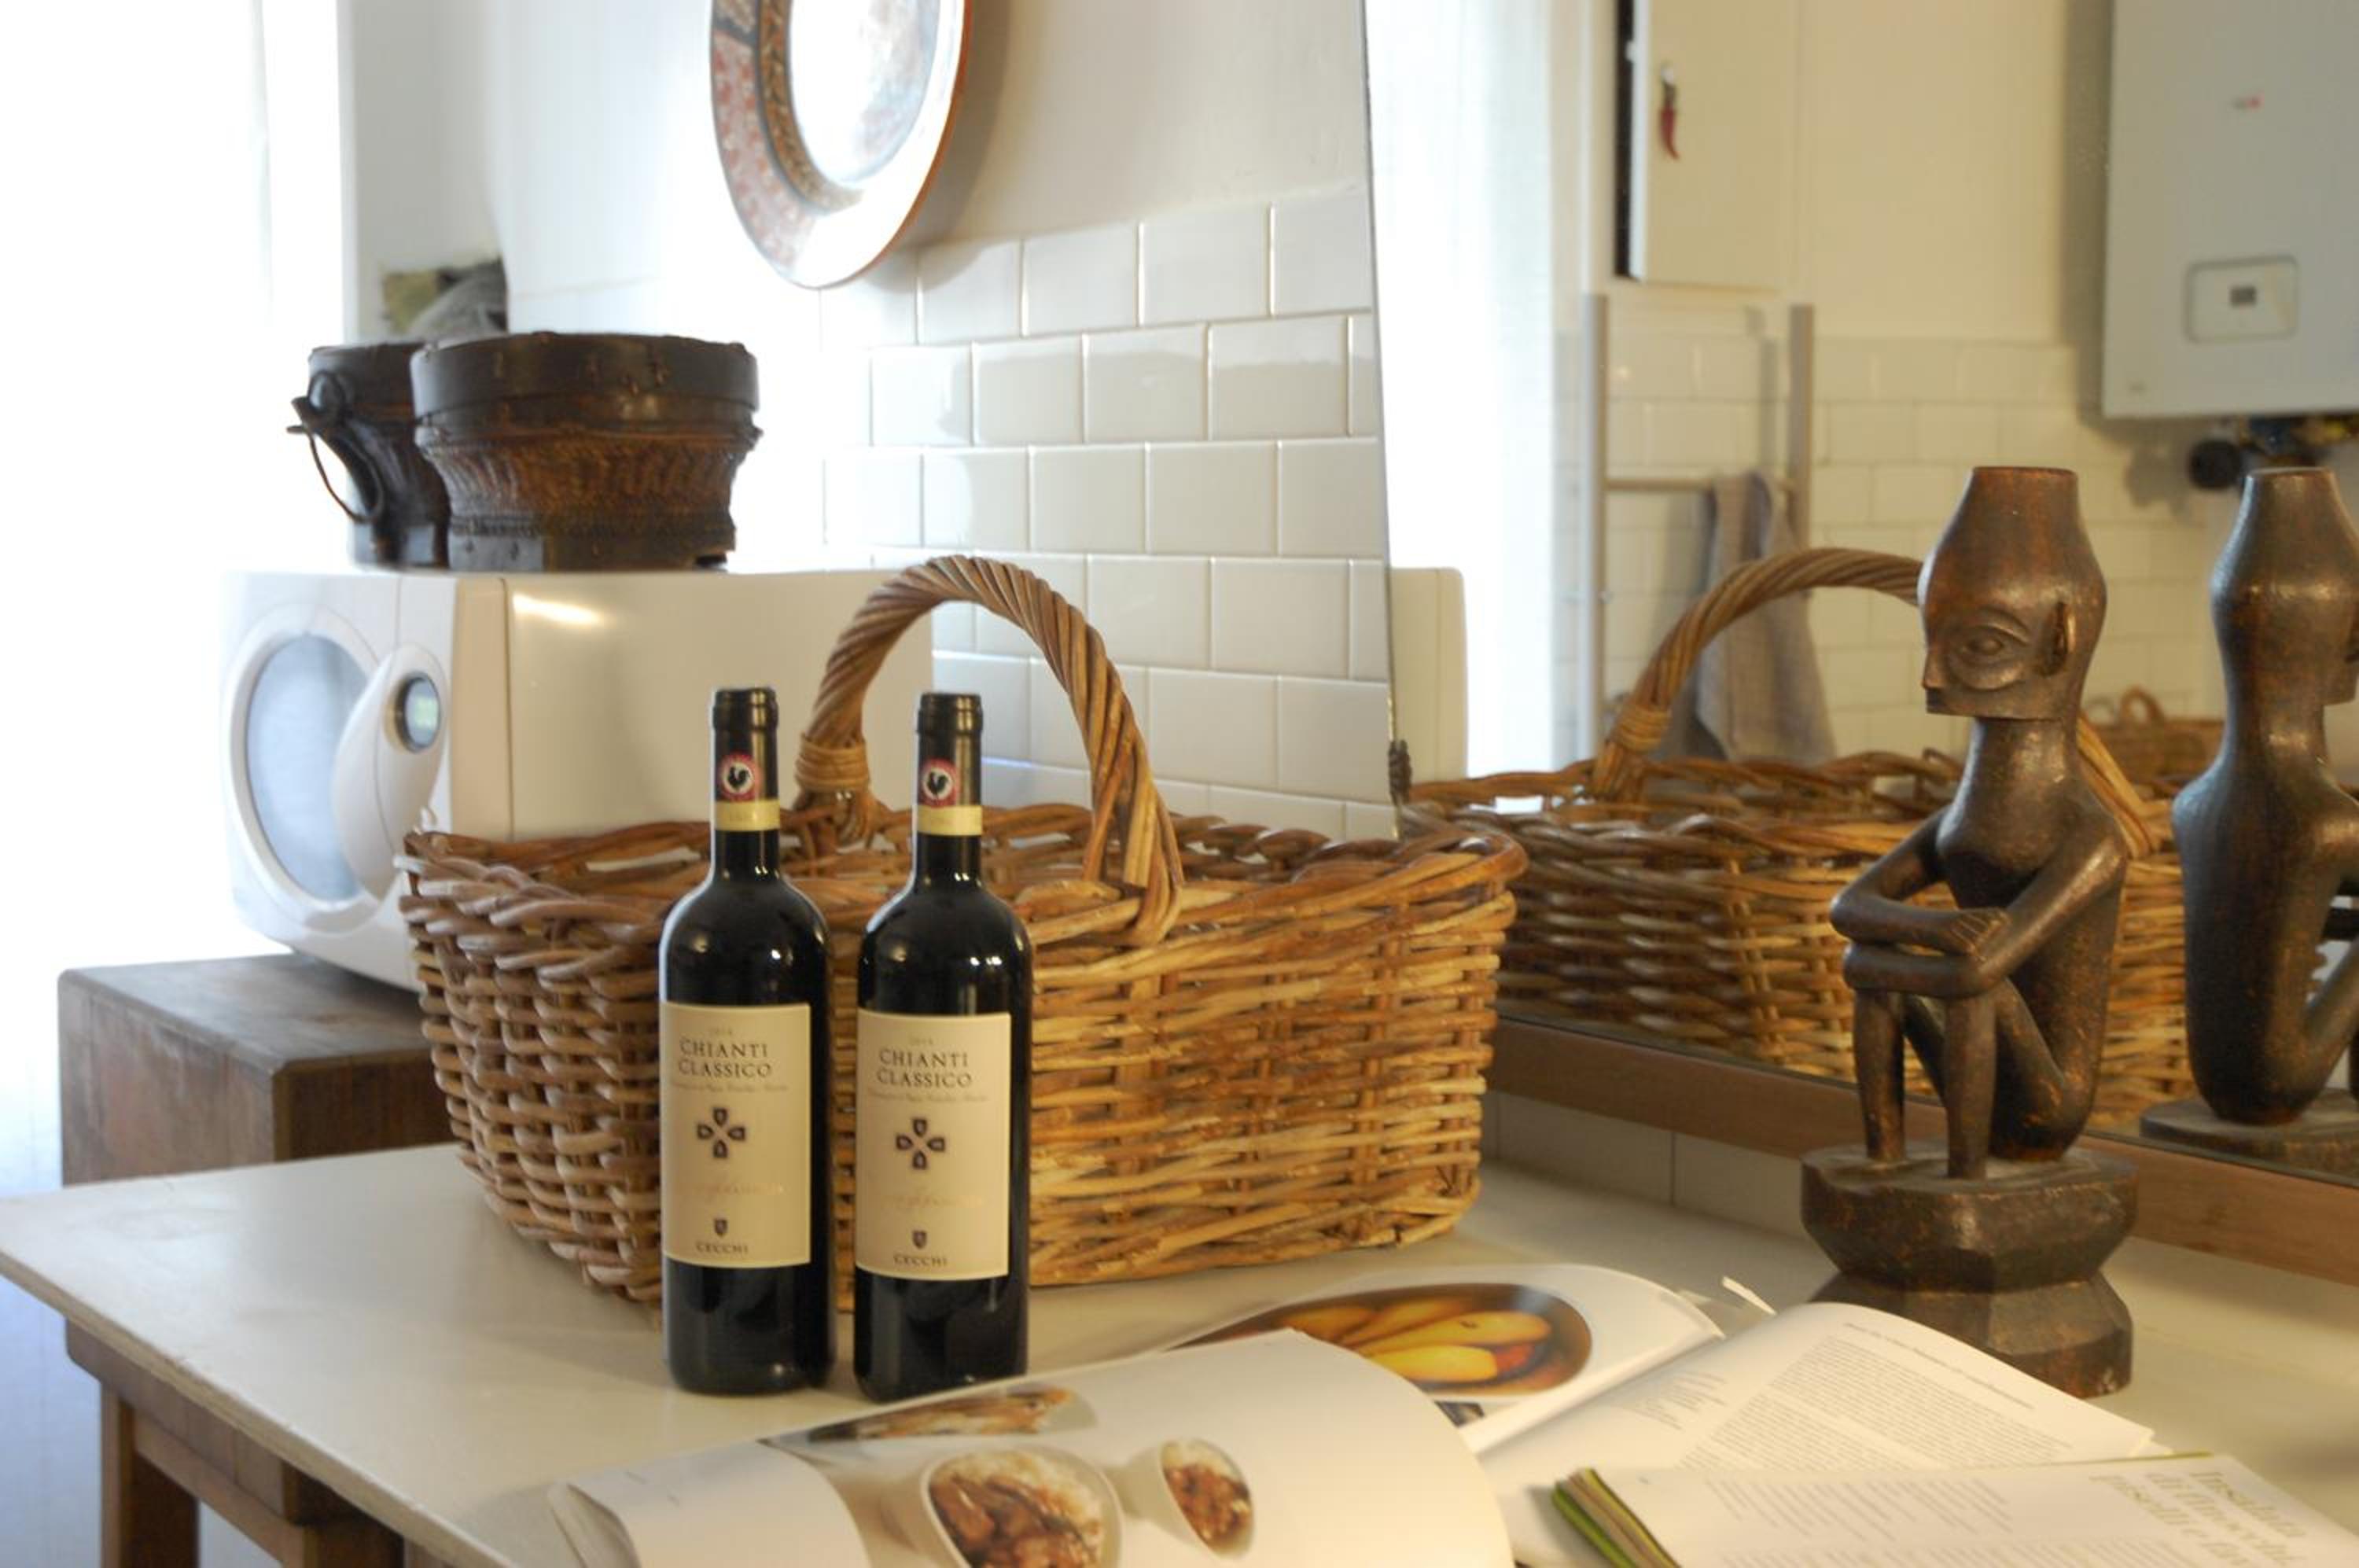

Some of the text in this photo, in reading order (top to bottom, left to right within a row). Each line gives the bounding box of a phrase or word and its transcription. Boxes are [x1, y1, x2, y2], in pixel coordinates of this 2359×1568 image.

[679, 1036, 768, 1058] CHIANTI
[878, 1047, 969, 1068] CHIANTI
[677, 1058, 773, 1079] CLASSICO
[876, 1066, 973, 1088] CLASSICO
[694, 1240, 749, 1255] CECCHI
[893, 1253, 948, 1267] CECCHI
